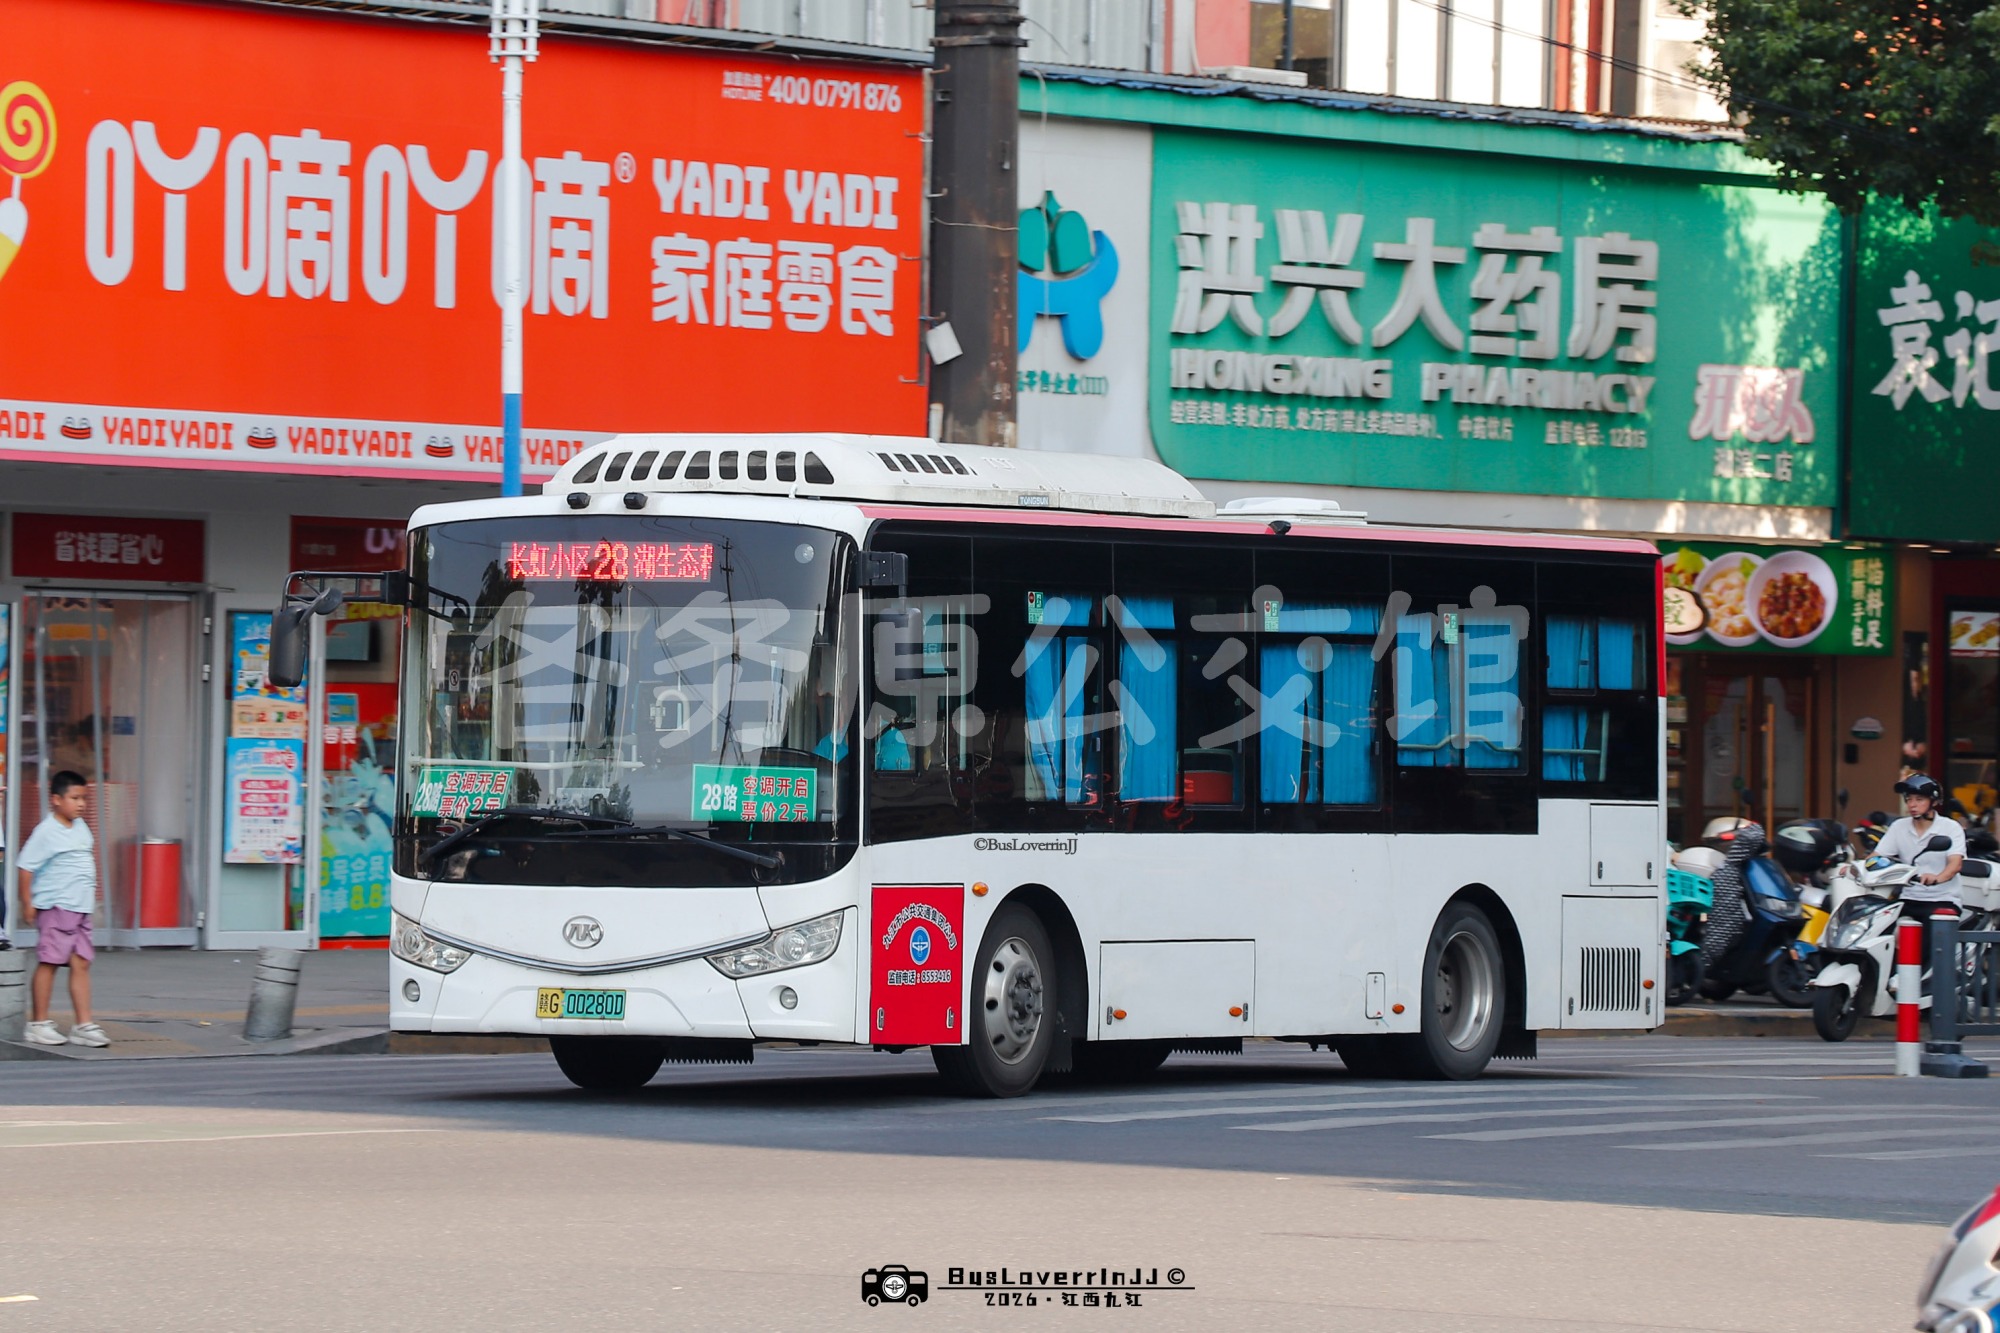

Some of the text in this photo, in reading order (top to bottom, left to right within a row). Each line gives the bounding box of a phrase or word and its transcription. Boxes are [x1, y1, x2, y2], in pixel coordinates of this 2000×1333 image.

[722, 87, 763, 102] HOTLINE
[652, 157, 898, 230] YADI YADI
[651, 232, 898, 337] 家庭零食
[1171, 201, 1659, 364] 洪兴大药房
[1871, 269, 2000, 411] 袁记
[1171, 348, 1657, 414] HONGXING PHARMACY
[103, 416, 235, 450] YADIYADI
[288, 426, 412, 459] YADIYADI
[55, 531, 164, 565] 省钱更省心
[507, 542, 593, 579] 长虹小区
[593, 543, 629, 580] 28
[444, 772, 508, 795] 空调开启
[701, 783, 738, 812] 28路
[743, 775, 809, 798] 空调开启
[741, 801, 808, 823] 票价2元
